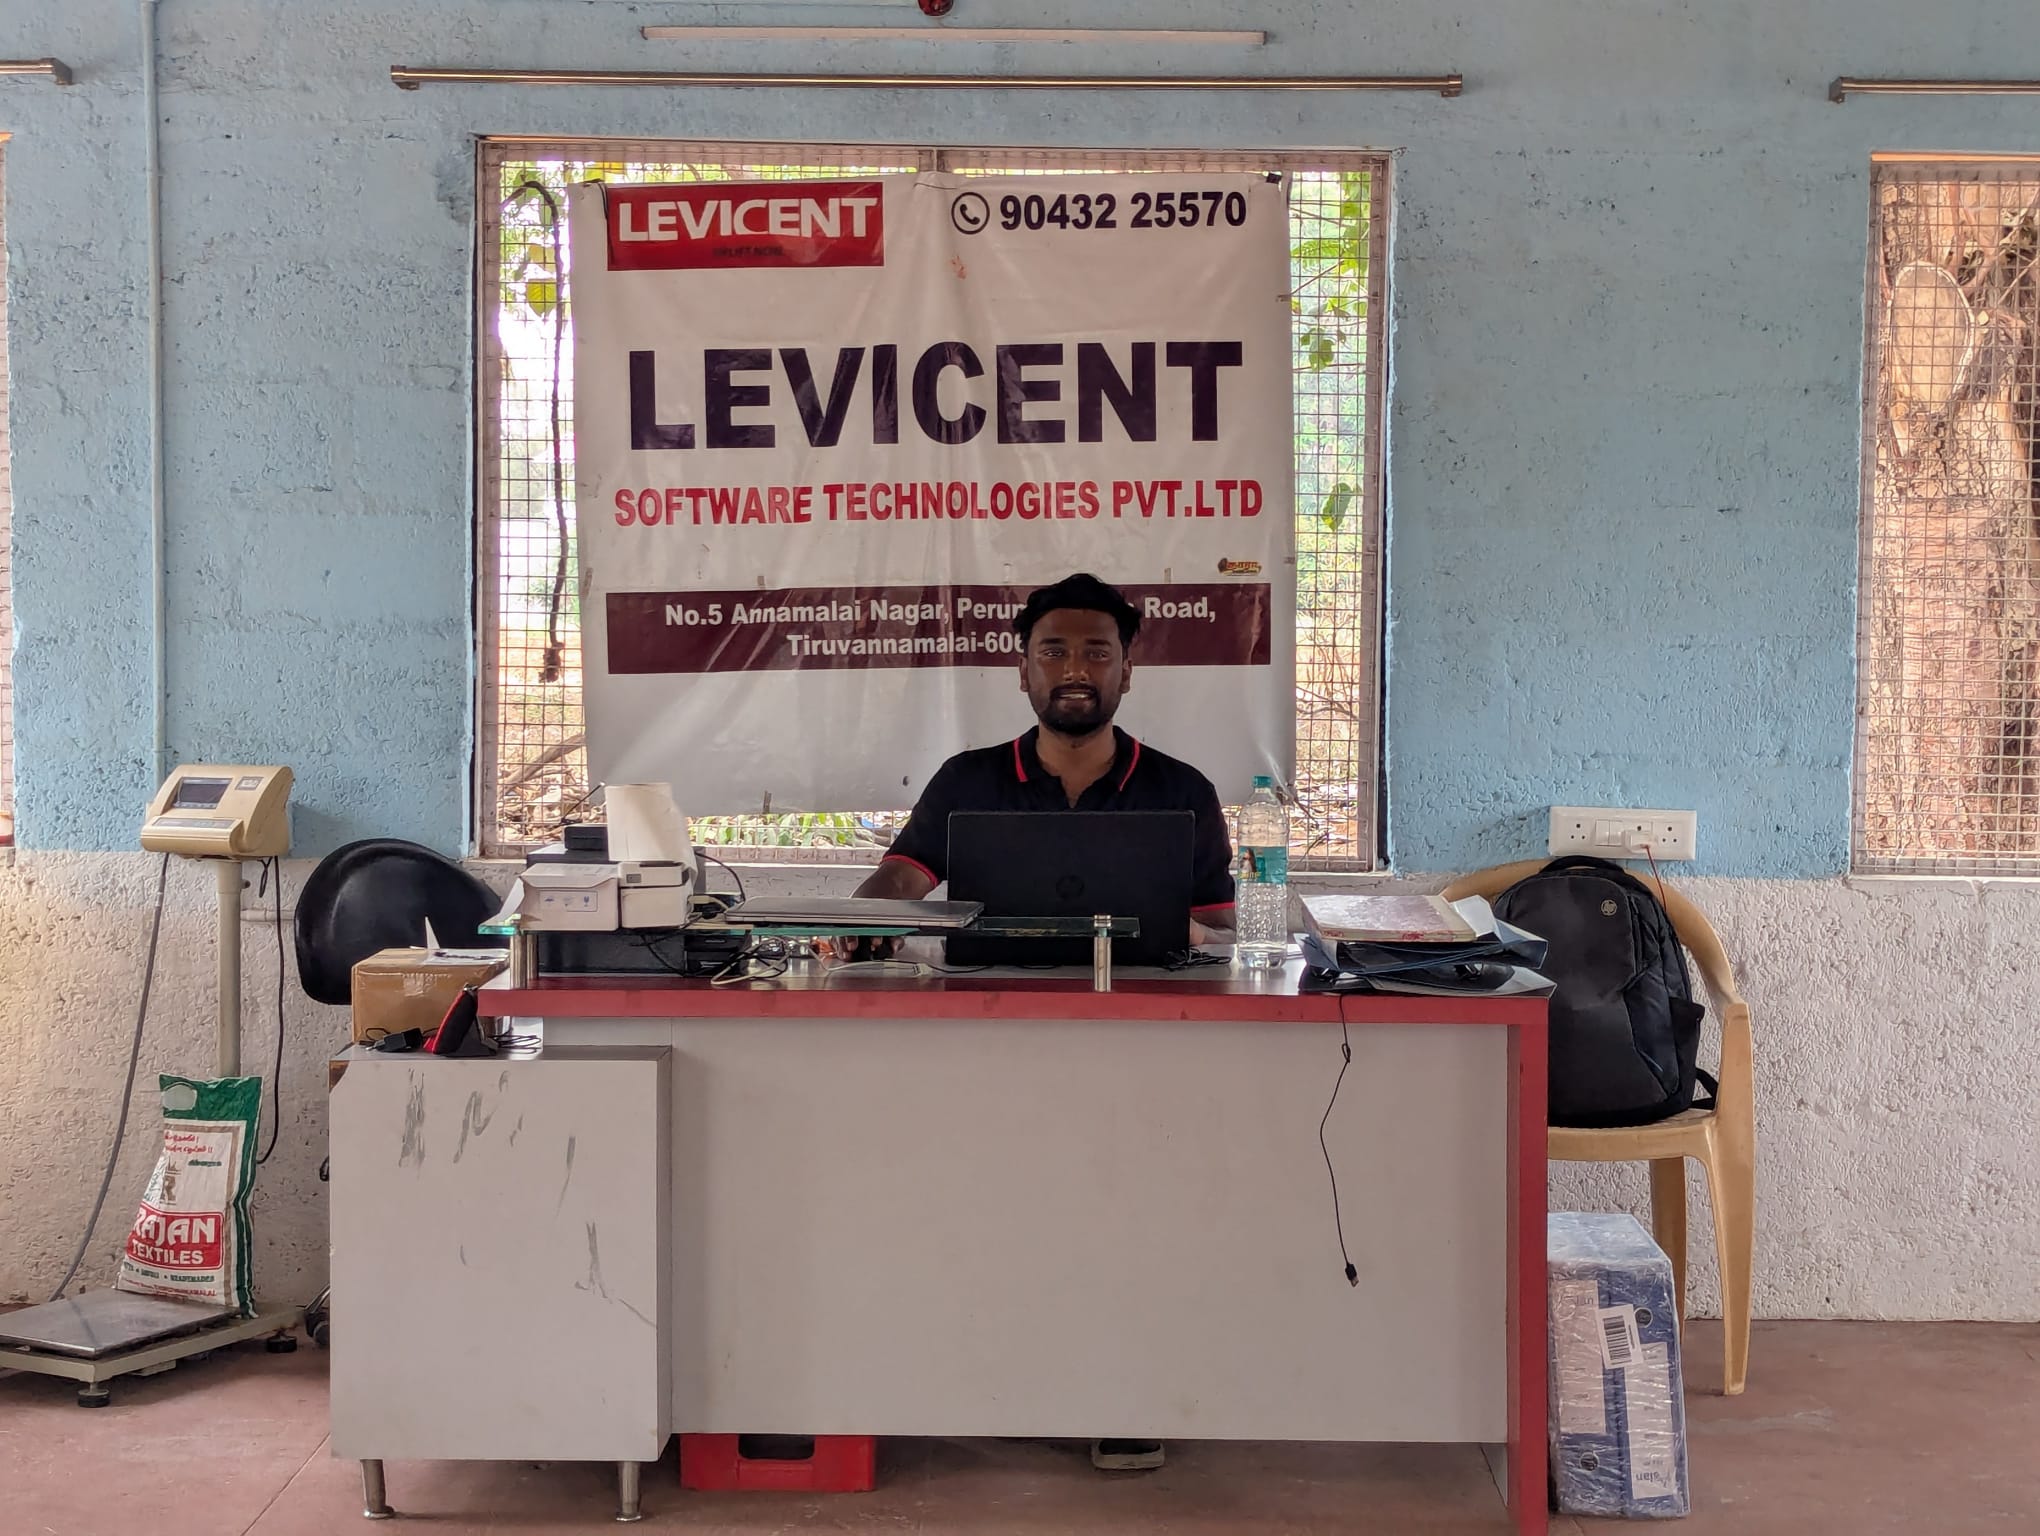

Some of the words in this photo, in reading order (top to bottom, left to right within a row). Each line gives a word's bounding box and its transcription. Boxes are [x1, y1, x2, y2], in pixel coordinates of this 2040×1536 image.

[618, 198, 877, 241] LEVICENT
[1000, 193, 1117, 231] 90432
[1130, 190, 1247, 228] 25570
[629, 342, 1243, 450] LEVICENT
[614, 487, 812, 527] SOFTWARE
[823, 481, 1100, 522] TECHNOLOGIES
[1112, 479, 1264, 519] PVT.LTD
[665, 604, 723, 627] No.5
[731, 600, 861, 624] Annamalai
[870, 600, 950, 626] Nagar,
[1144, 597, 1216, 623] Road,
[133, 1207, 215, 1246] RAJAN
[132, 1239, 204, 1264] TEXTILES
